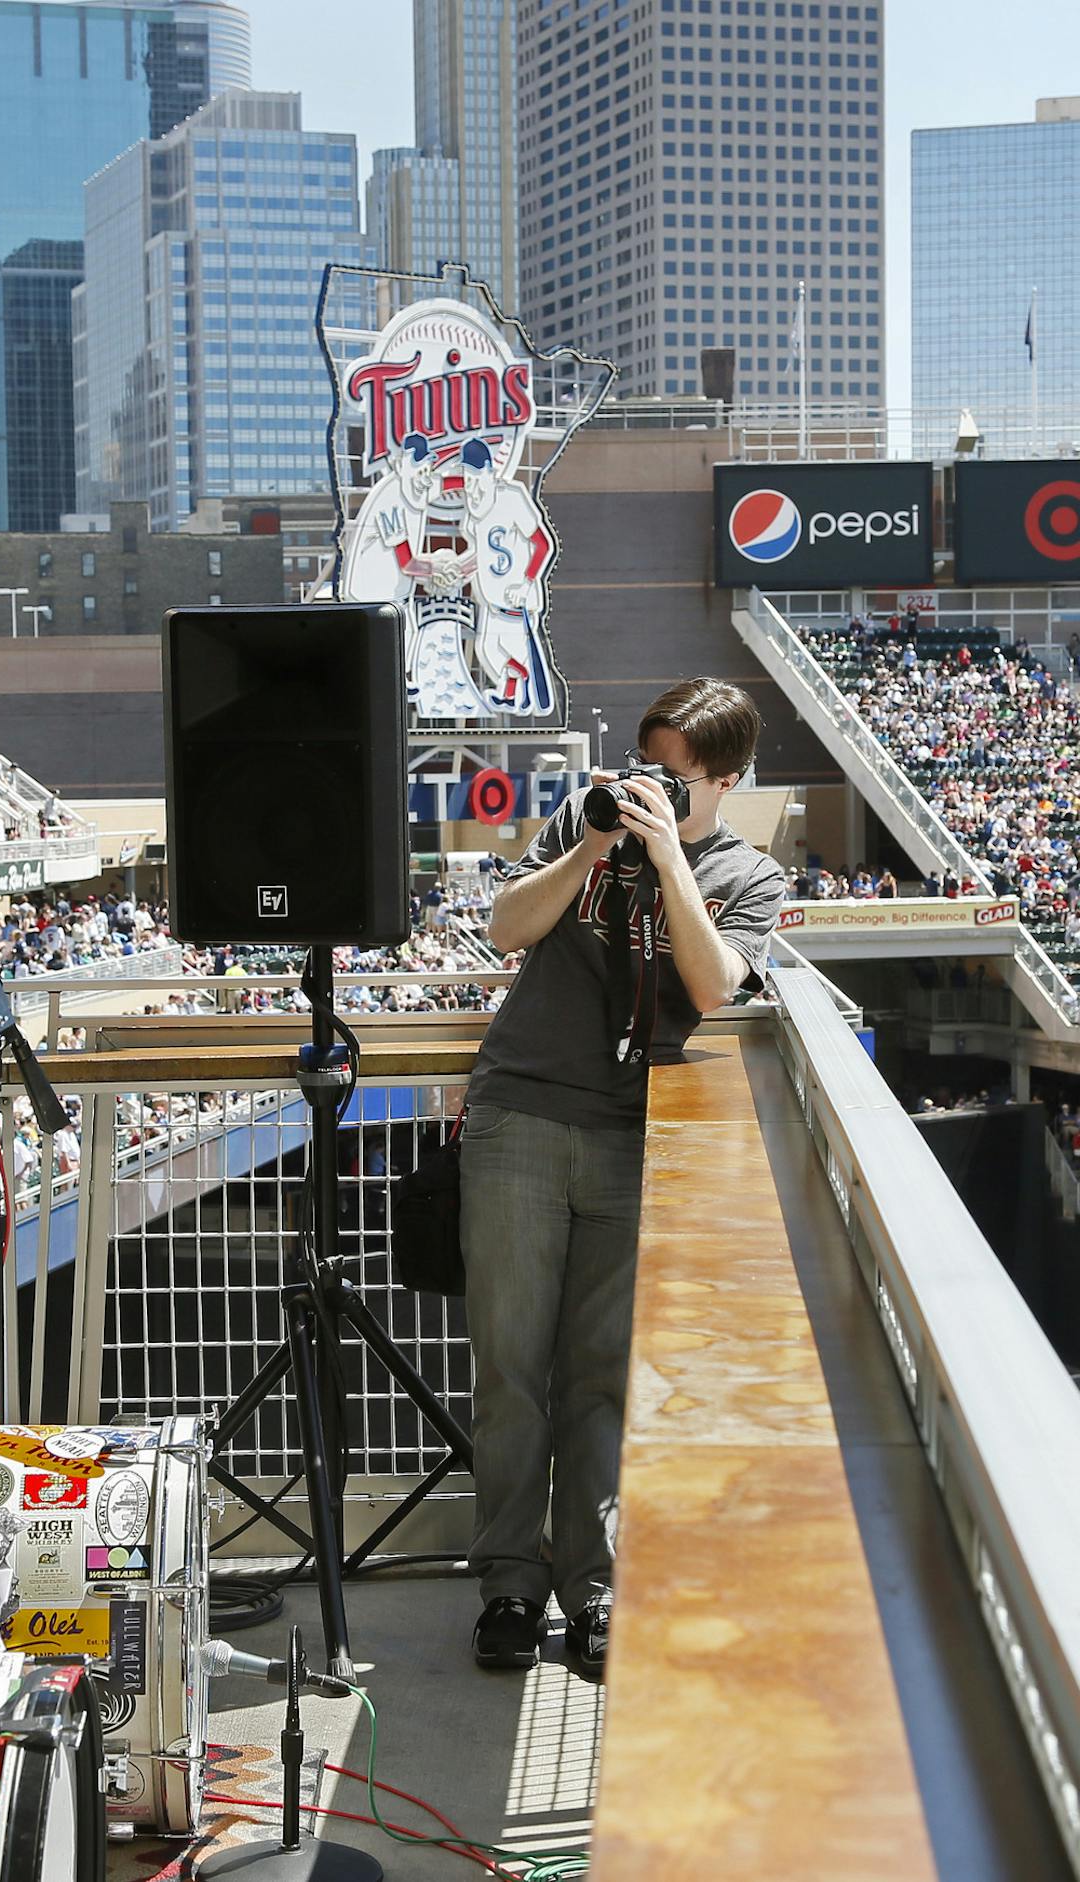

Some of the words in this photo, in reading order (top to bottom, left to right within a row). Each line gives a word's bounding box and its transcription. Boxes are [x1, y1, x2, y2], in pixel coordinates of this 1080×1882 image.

[348, 350, 533, 464] Twins
[809, 504, 920, 545] pepsi
[778, 911, 803, 928] LAD
[809, 914, 840, 925] Small
[842, 911, 887, 927] Change.
[892, 911, 909, 925] Big
[911, 910, 969, 923] Difference.
[976, 904, 1014, 924] GLAD
[643, 914, 652, 961] Canon
[99, 1484, 113, 1534] SEATTLE
[130, 1481, 148, 1539] WASHINGTON
[27, 1520, 73, 1532] HIGH
[27, 1531, 73, 1540] WEST
[89, 1570, 110, 1579] WEST
[110, 1570, 121, 1579] OF
[28, 1611, 85, 1637] Ole's
[120, 1608, 141, 1690] LULLWATER
